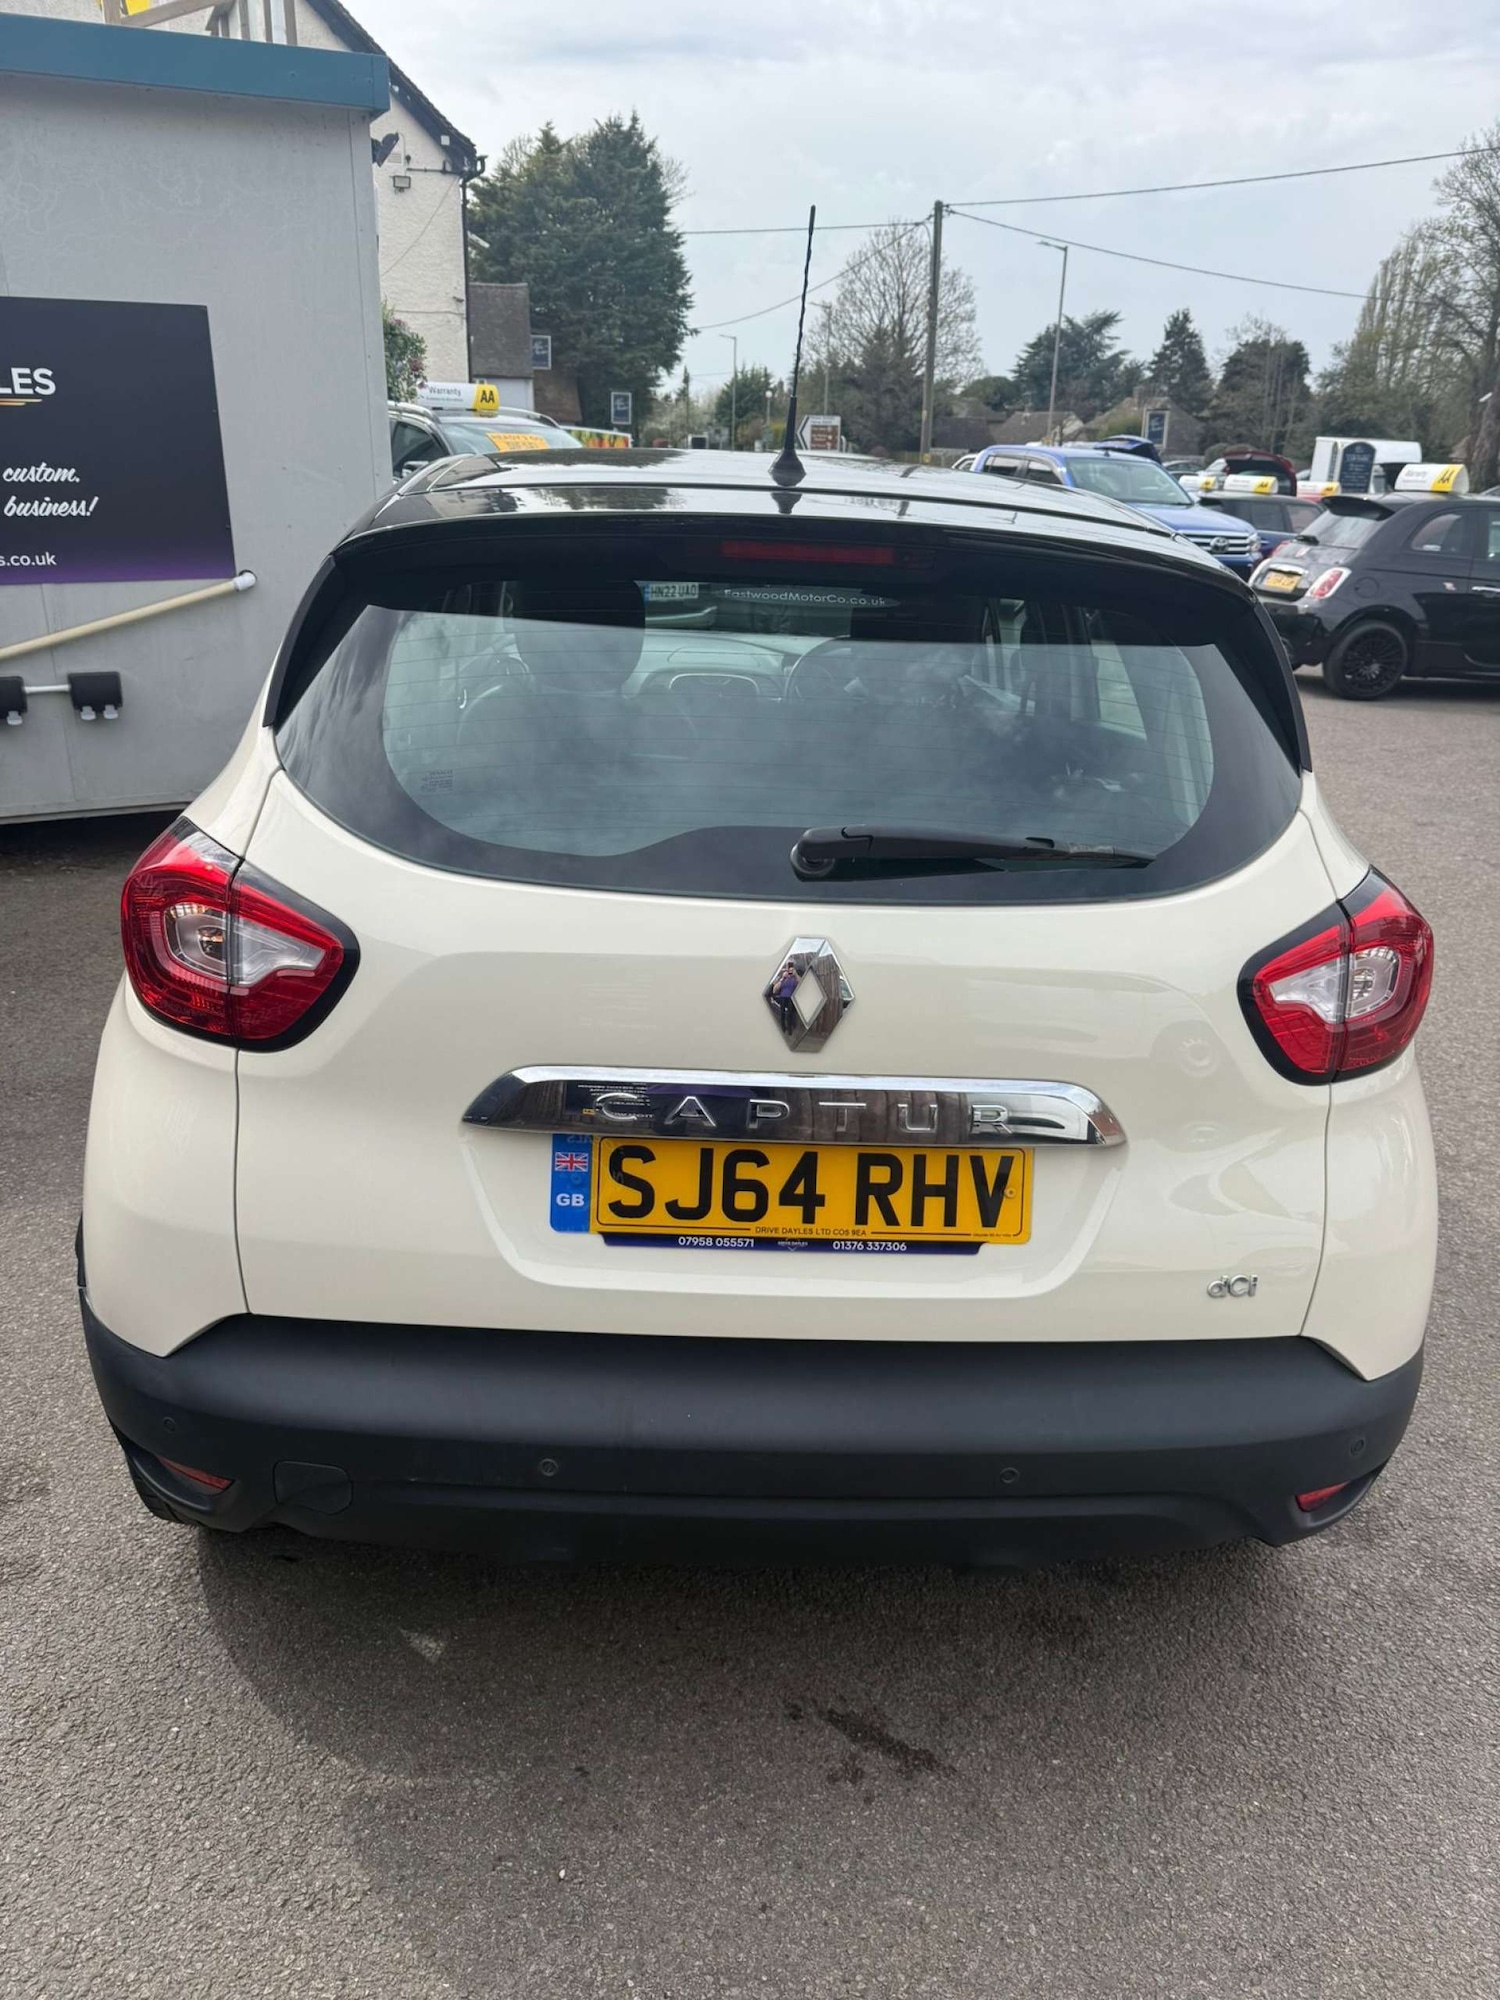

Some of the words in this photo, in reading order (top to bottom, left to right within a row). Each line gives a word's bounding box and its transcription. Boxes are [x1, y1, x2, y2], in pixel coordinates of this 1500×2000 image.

[480, 390, 495, 403] AA
[2, 462, 81, 483] custom.
[3, 495, 99, 517] business!
[594, 1092, 1013, 1136] CAPTUR
[608, 1144, 826, 1224] SJ64
[854, 1152, 1016, 1229] RHV
[556, 1193, 585, 1206] GB
[755, 1226, 780, 1234] DRIVE
[781, 1227, 814, 1236] DAYLES
[815, 1228, 831, 1236] LTD
[678, 1235, 713, 1246] 07958
[715, 1237, 755, 1248] 055571
[832, 1241, 864, 1250] 01376
[866, 1242, 907, 1251] 337306
[1207, 1275, 1258, 1298] dCi
